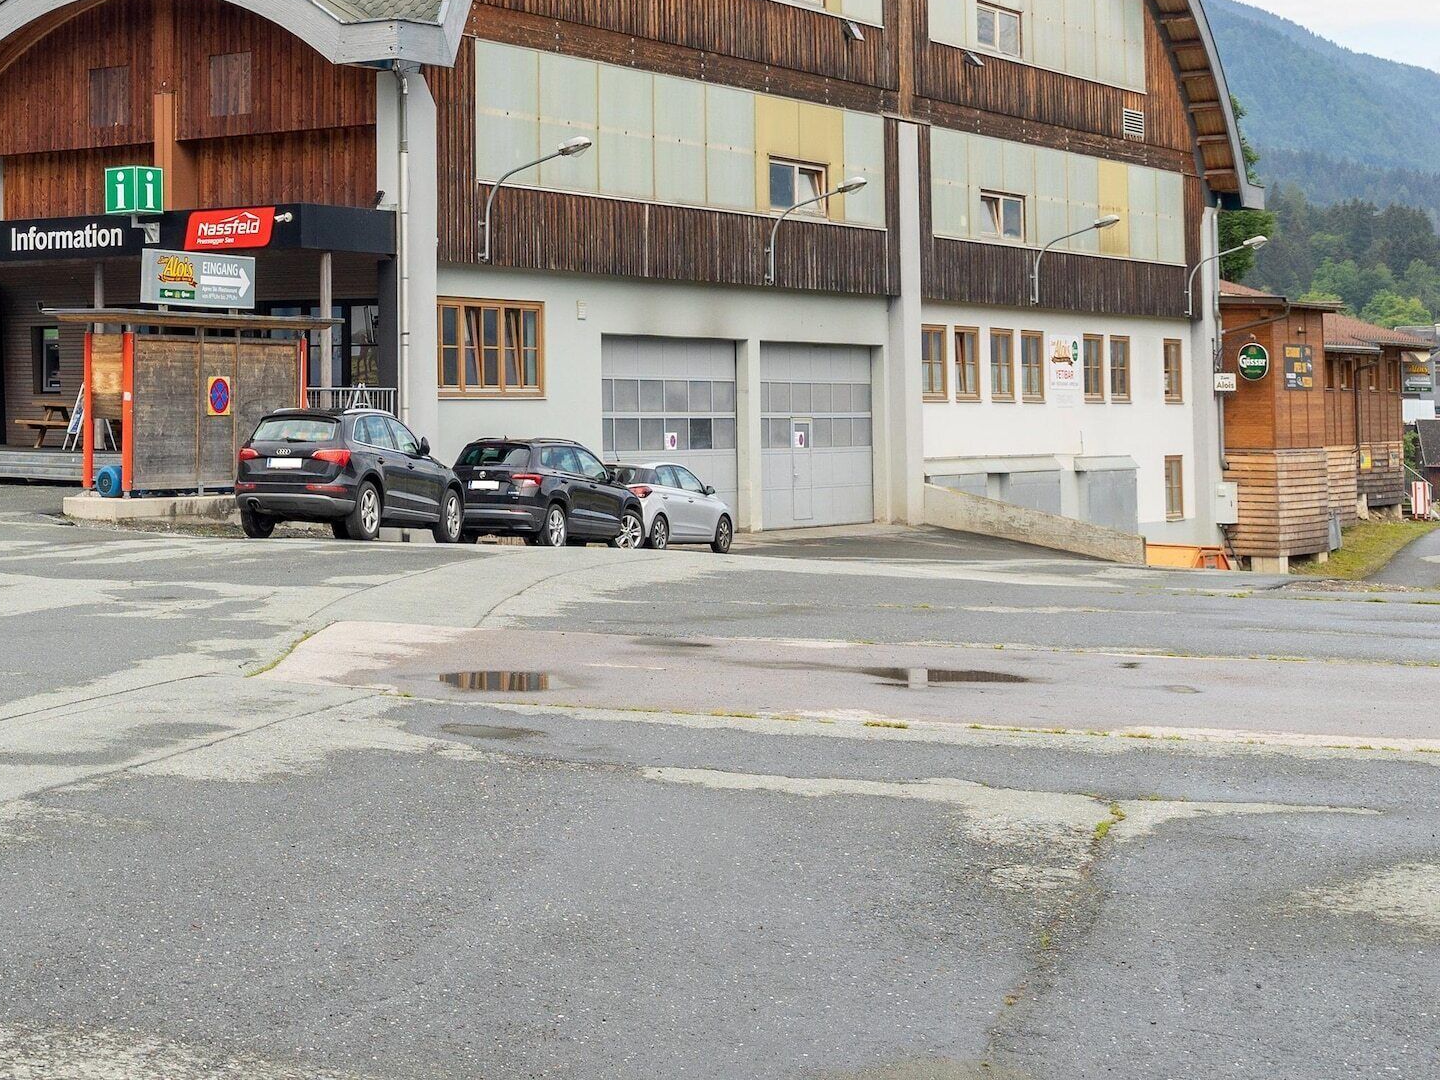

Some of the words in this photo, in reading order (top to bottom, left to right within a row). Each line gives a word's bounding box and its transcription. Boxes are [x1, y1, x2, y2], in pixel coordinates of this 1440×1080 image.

[197, 217, 260, 237] Nassfeld
[11, 223, 123, 252] Information
[163, 255, 194, 277] Alois
[202, 261, 239, 276] EINGANG
[1239, 354, 1267, 369] Gösser
[1216, 381, 1235, 389] Alois
